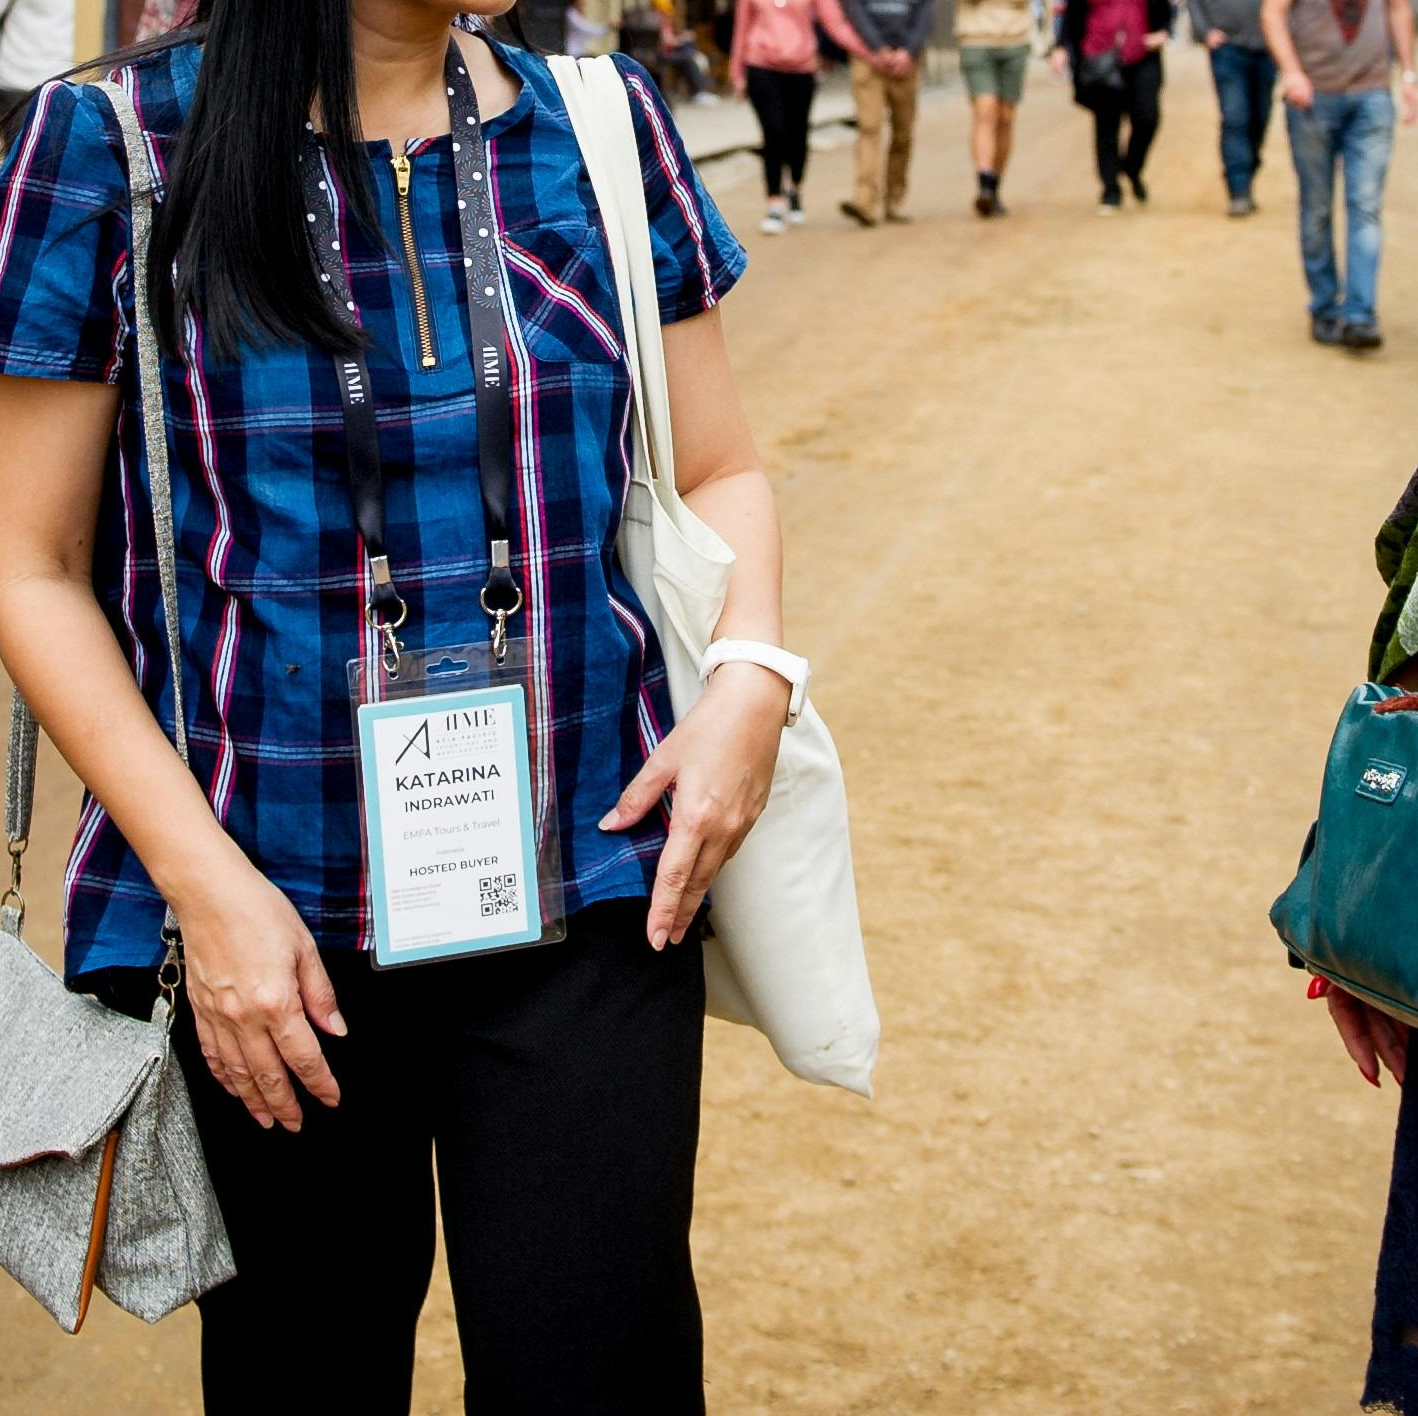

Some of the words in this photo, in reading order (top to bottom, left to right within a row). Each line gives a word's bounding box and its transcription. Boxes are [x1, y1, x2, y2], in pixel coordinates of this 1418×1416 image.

[395, 763, 501, 791] KATARINA
[404, 789, 495, 813] INDRAWATI
[471, 816, 501, 831] Travel
[409, 862, 458, 877] HOSTED
[460, 855, 499, 870] BUYER
